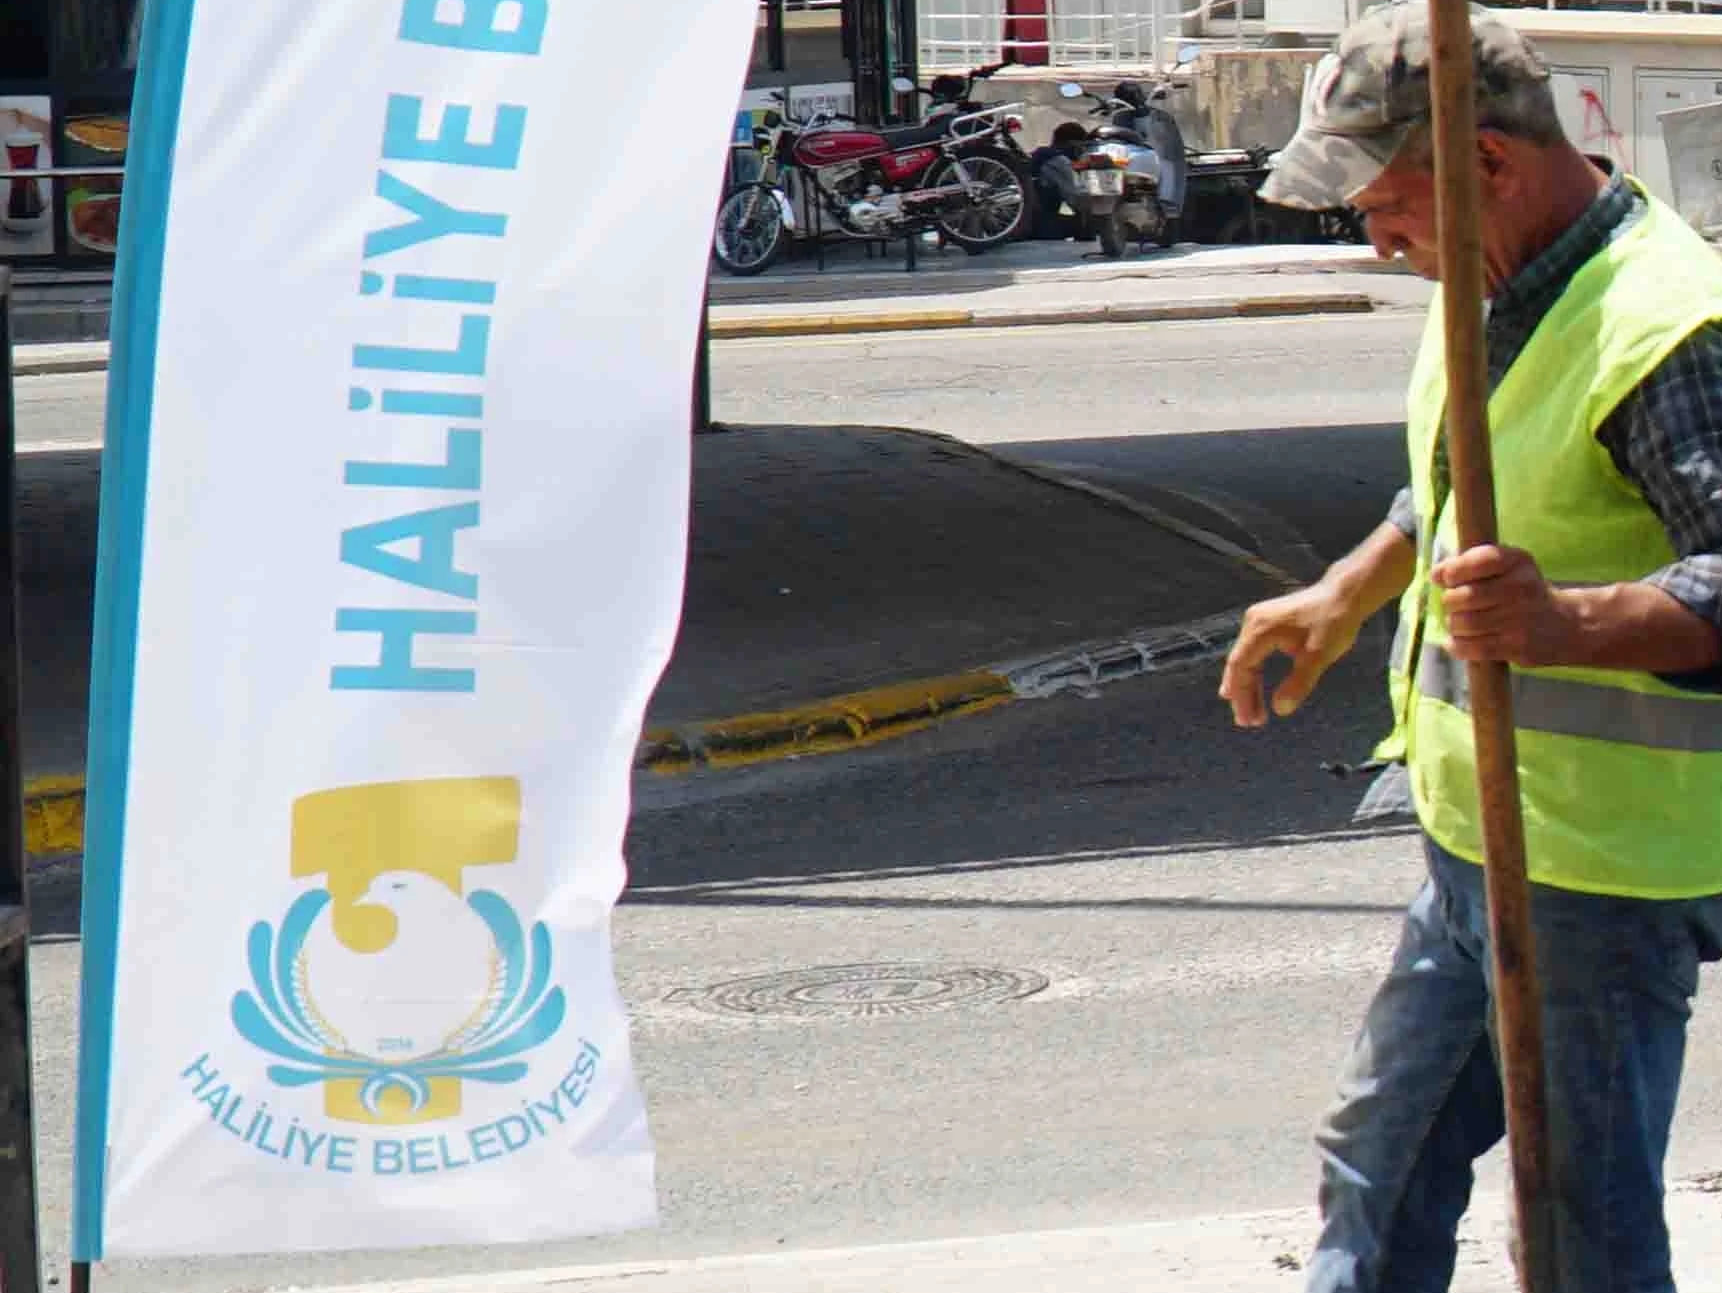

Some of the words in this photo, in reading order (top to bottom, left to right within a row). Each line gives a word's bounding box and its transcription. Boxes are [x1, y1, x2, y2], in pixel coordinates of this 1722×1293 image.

[329, 92, 526, 693] HALİLİYE
[179, 1051, 360, 1175] HALİLİYE
[371, 1036, 601, 1176] BELEDİYESİ
